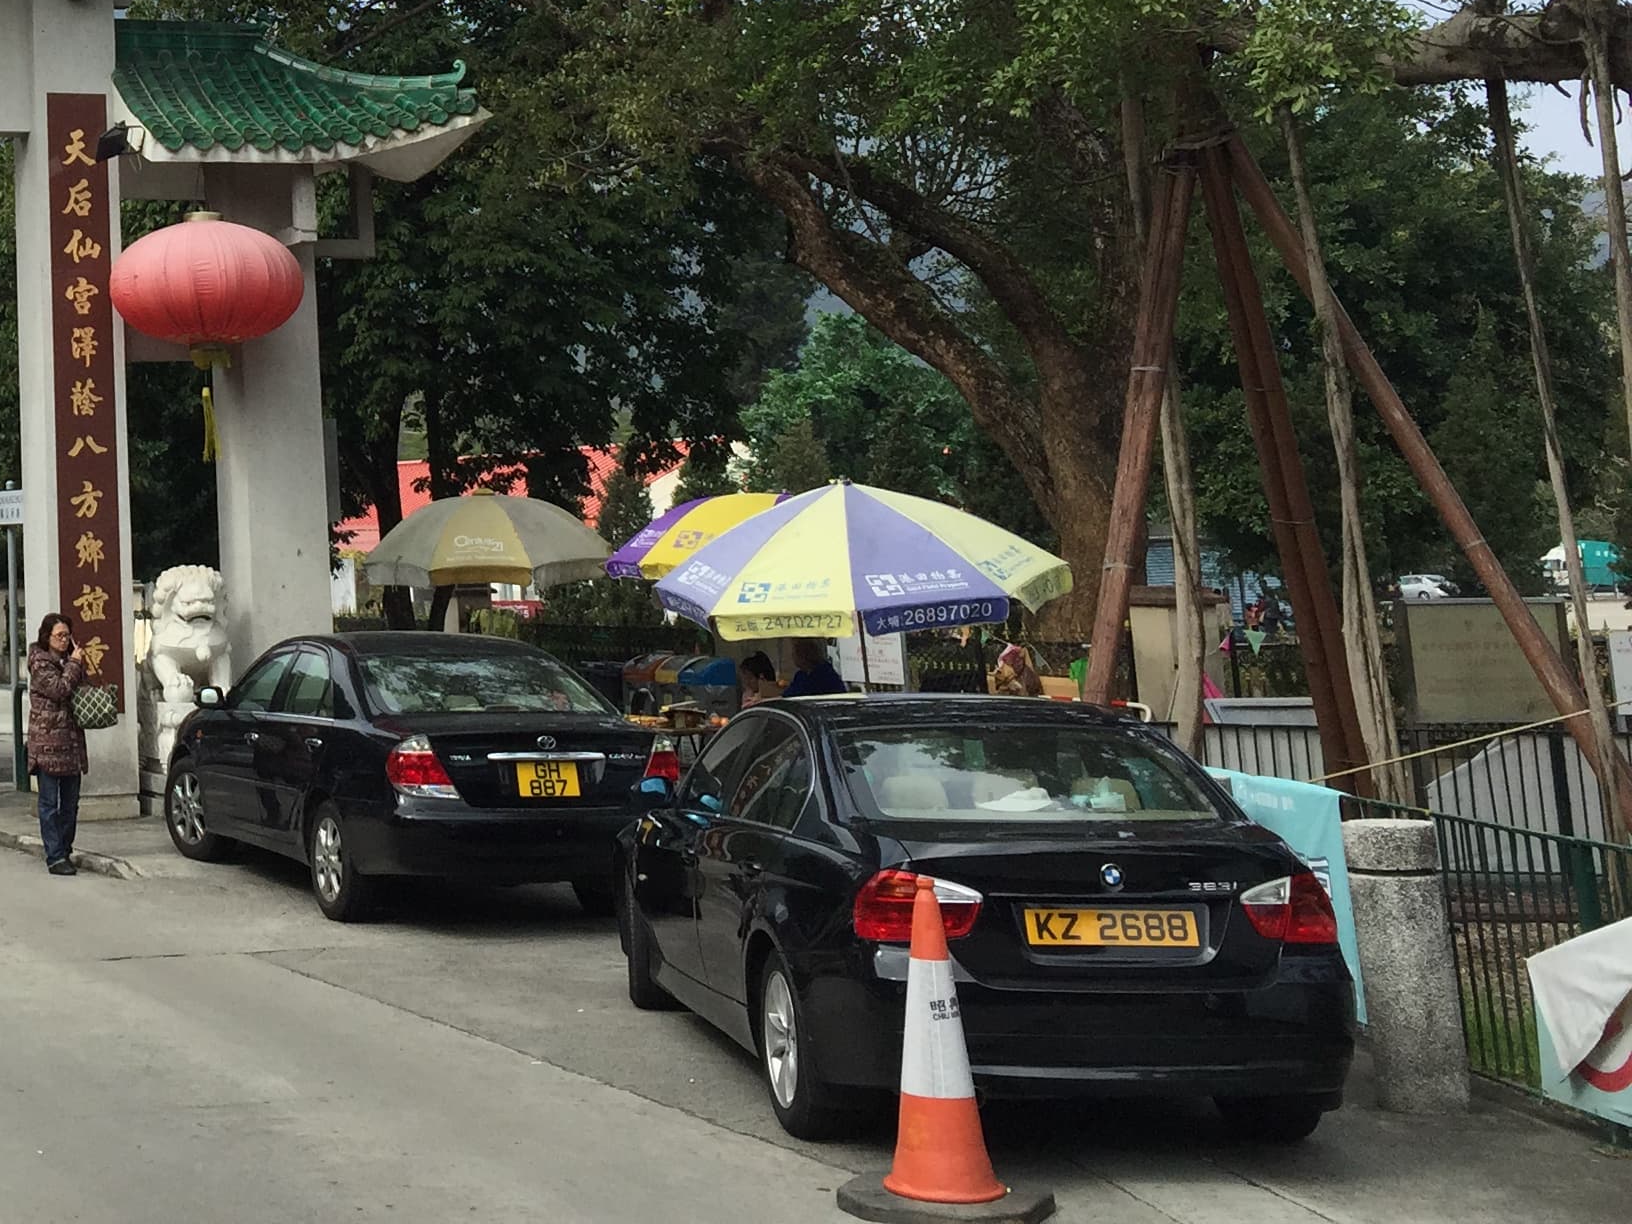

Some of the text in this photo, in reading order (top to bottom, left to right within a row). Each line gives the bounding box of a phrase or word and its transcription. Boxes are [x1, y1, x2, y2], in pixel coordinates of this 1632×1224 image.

[763, 614, 843, 631] 24702727
[904, 603, 992, 625] 26897020
[534, 763, 561, 778] GH
[529, 780, 568, 796] 887
[1034, 912, 1189, 942] KZ 2688
